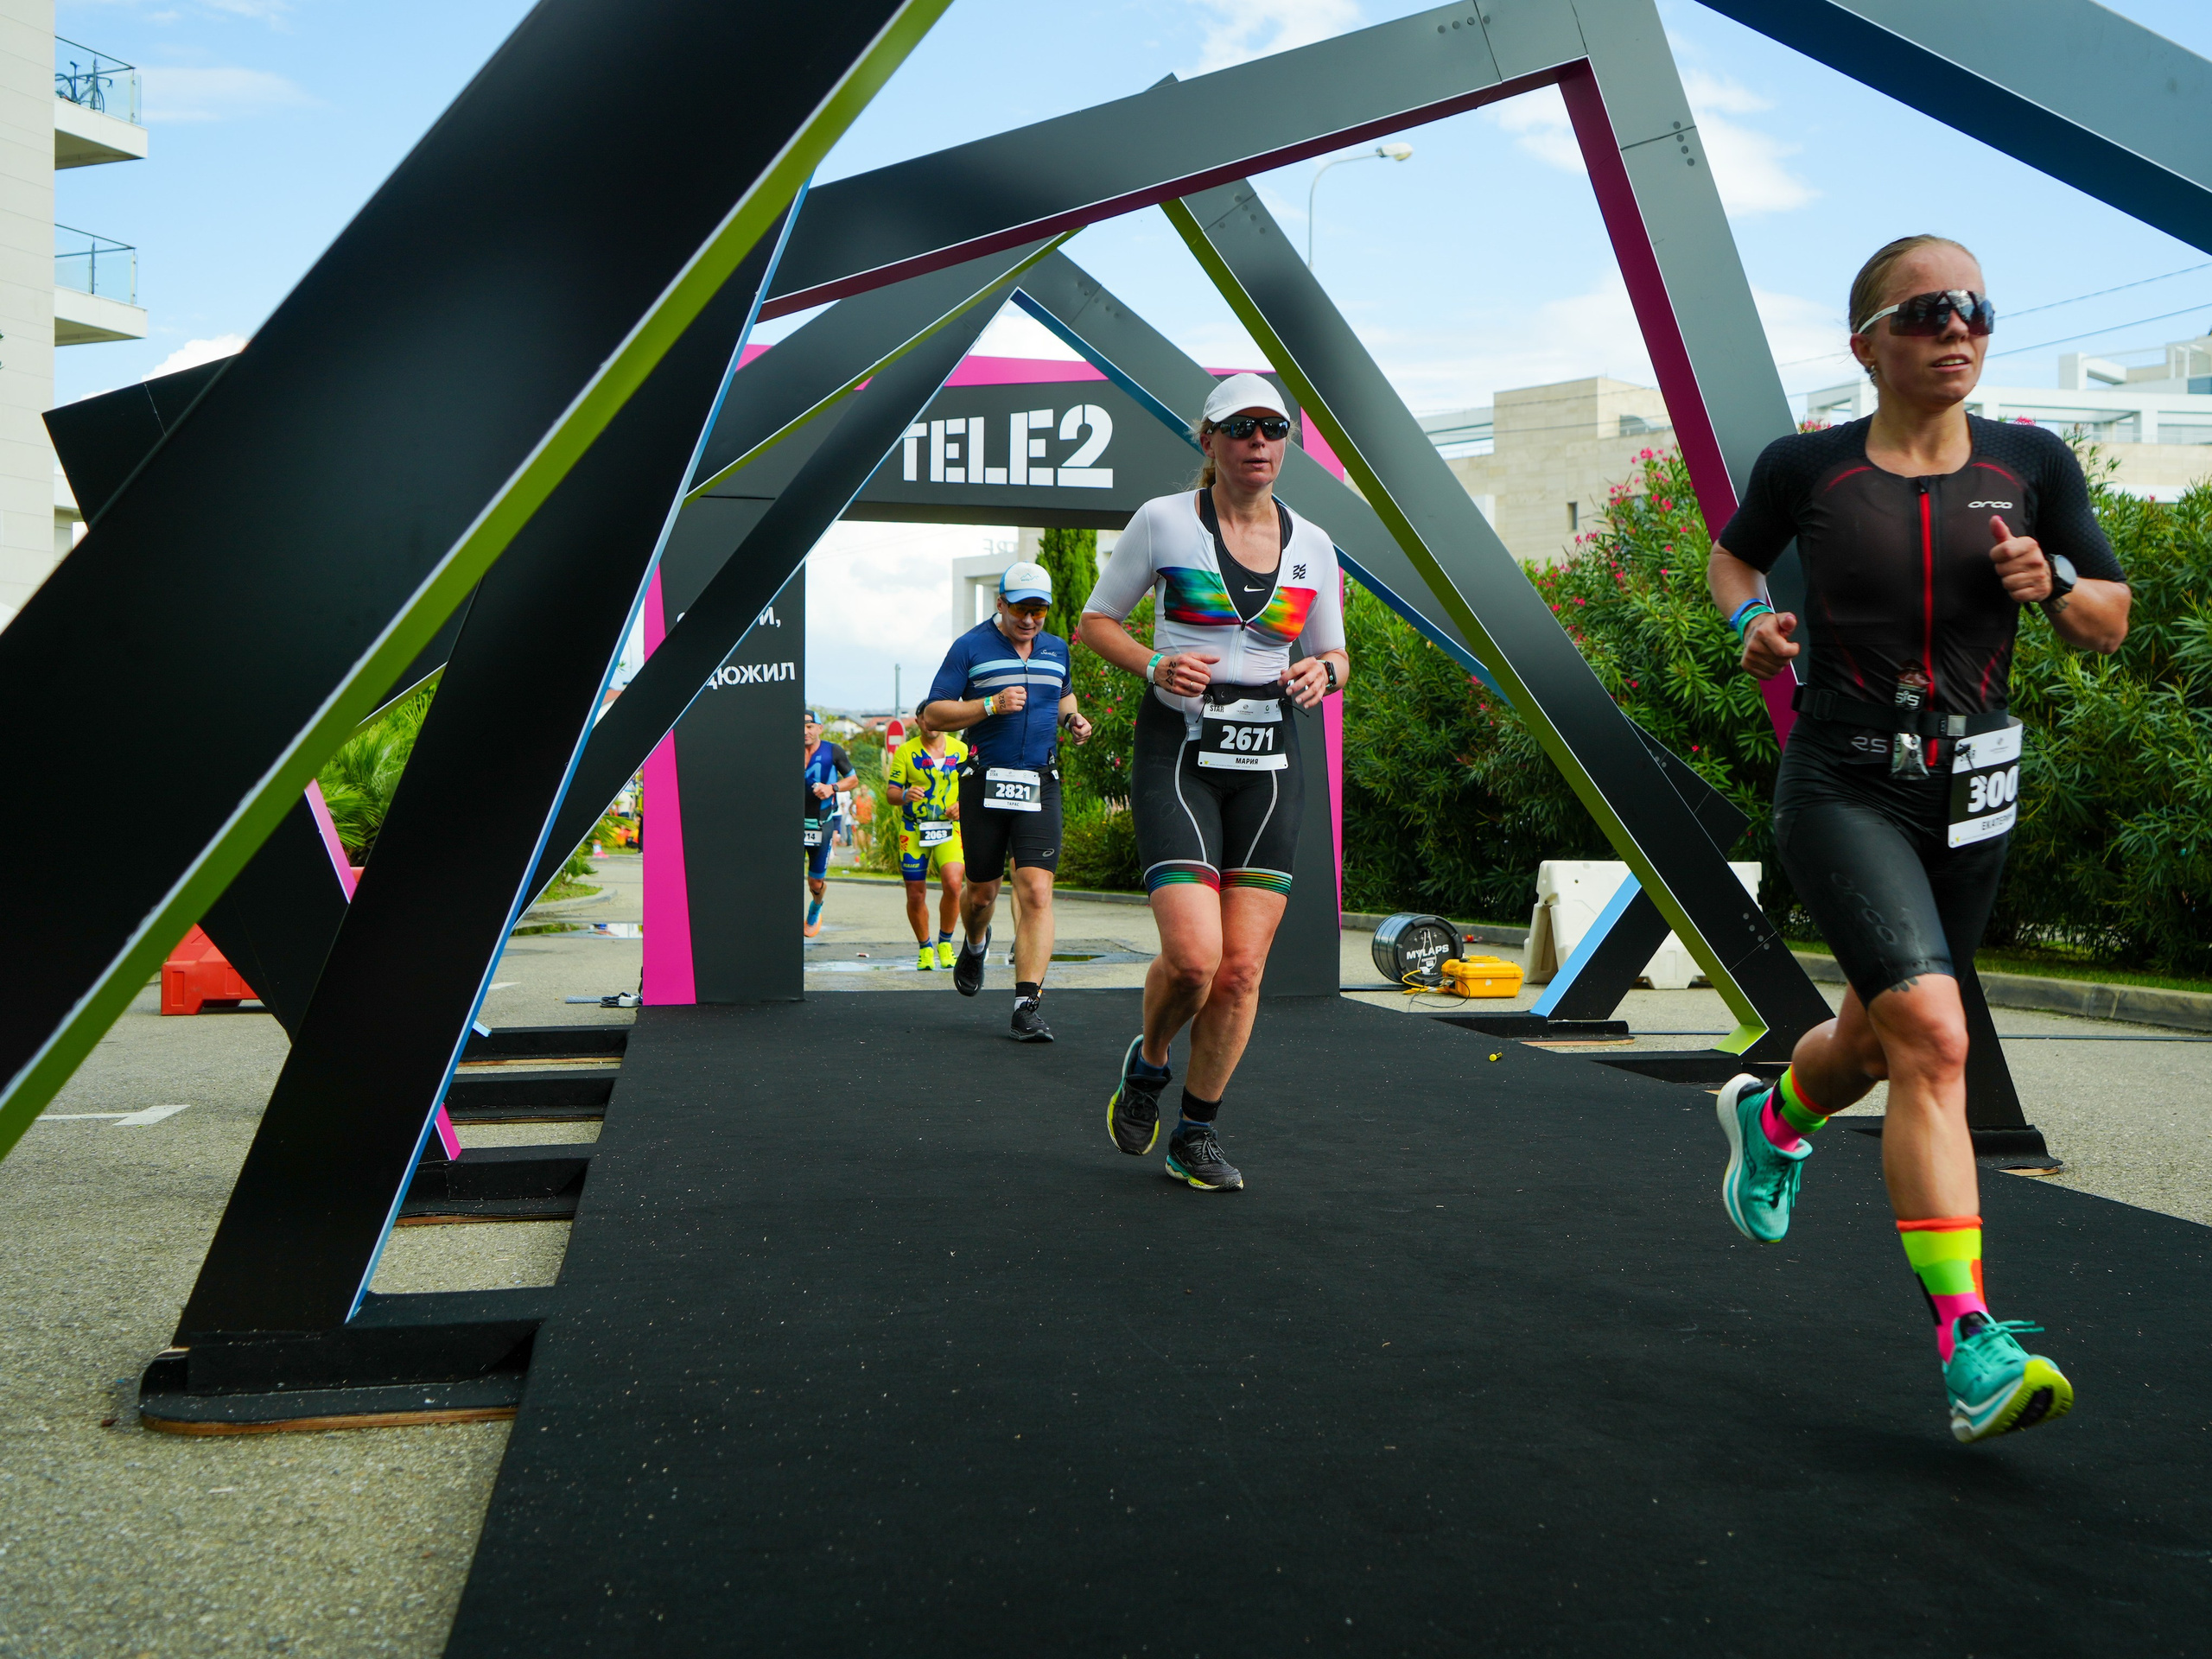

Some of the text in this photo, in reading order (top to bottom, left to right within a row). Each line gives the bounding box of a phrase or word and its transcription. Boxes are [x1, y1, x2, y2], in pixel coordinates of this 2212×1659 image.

[902, 404, 1114, 489] TELE2
[1967, 500, 2013, 509] orca
[1219, 724, 1274, 752] 2671
[1235, 757, 1259, 766] МАРИЯ
[995, 783, 1031, 800] 2821
[925, 830, 948, 840] 2063
[1406, 944, 1449, 960] MYLAPS
